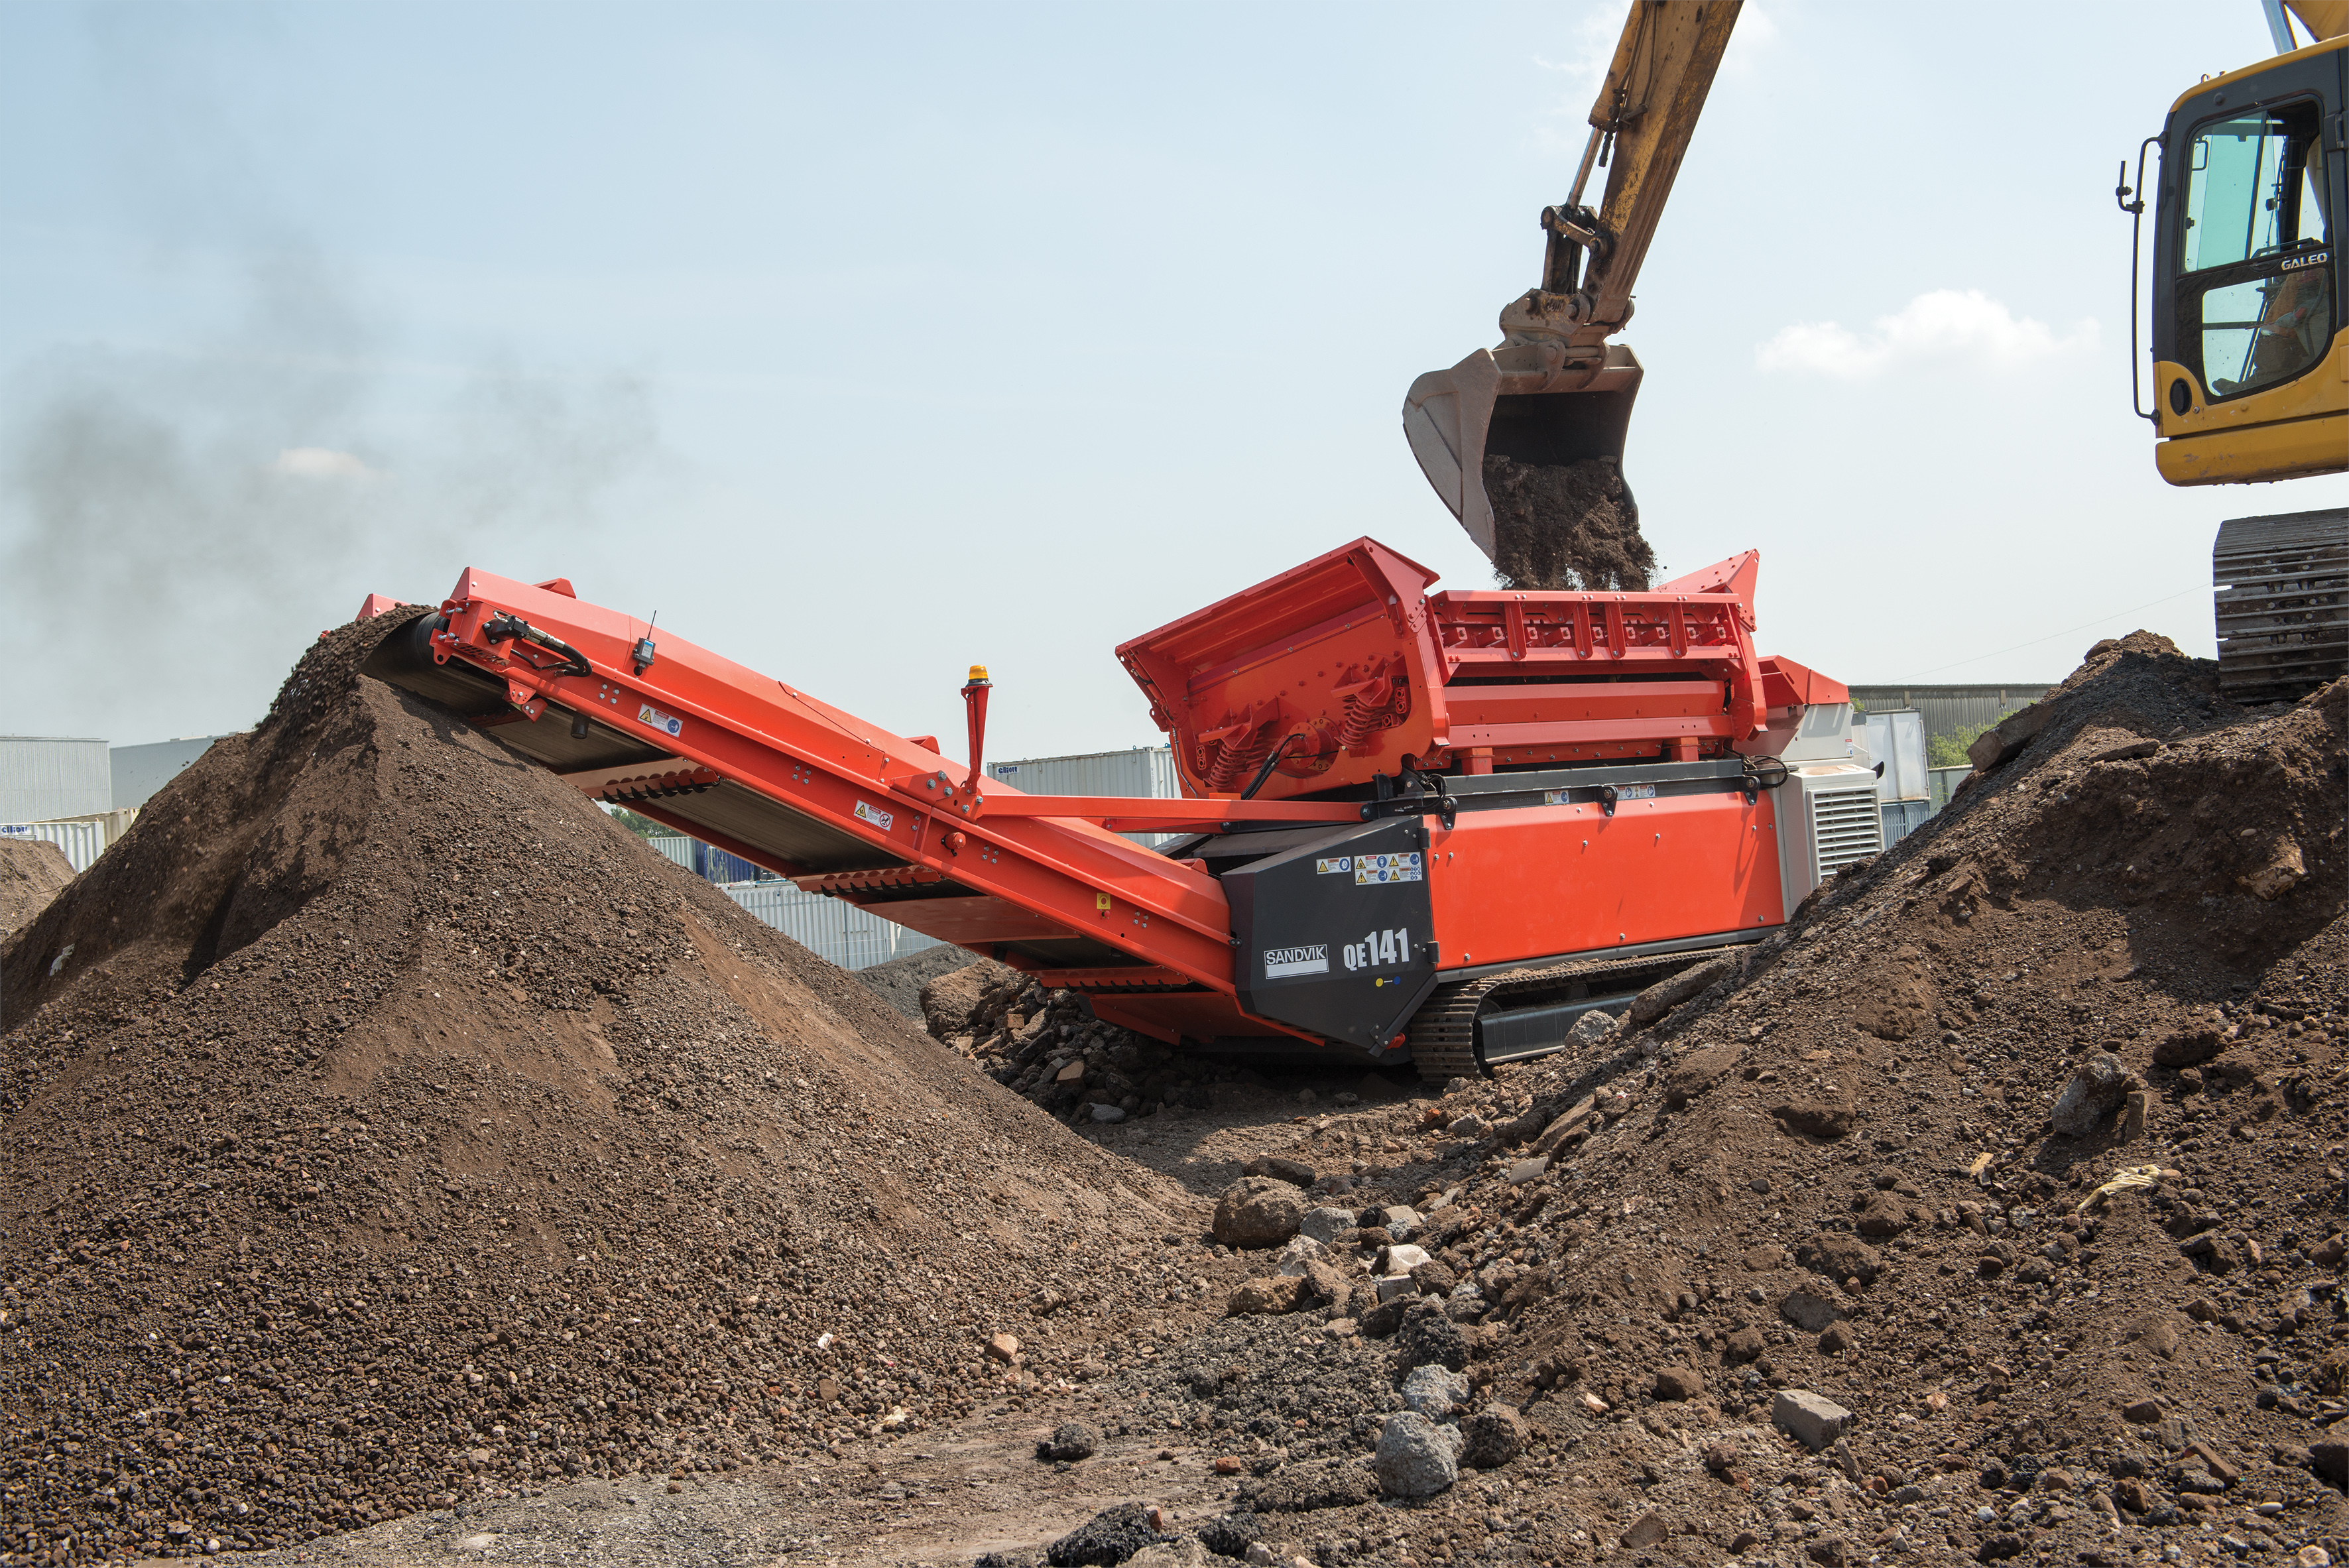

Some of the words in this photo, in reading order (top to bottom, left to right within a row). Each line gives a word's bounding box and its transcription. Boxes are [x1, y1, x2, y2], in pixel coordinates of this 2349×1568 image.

[2281, 253, 2328, 271] GALEO
[1266, 946, 1325, 965] SANDVIK
[1343, 928, 1410, 971] QE141
